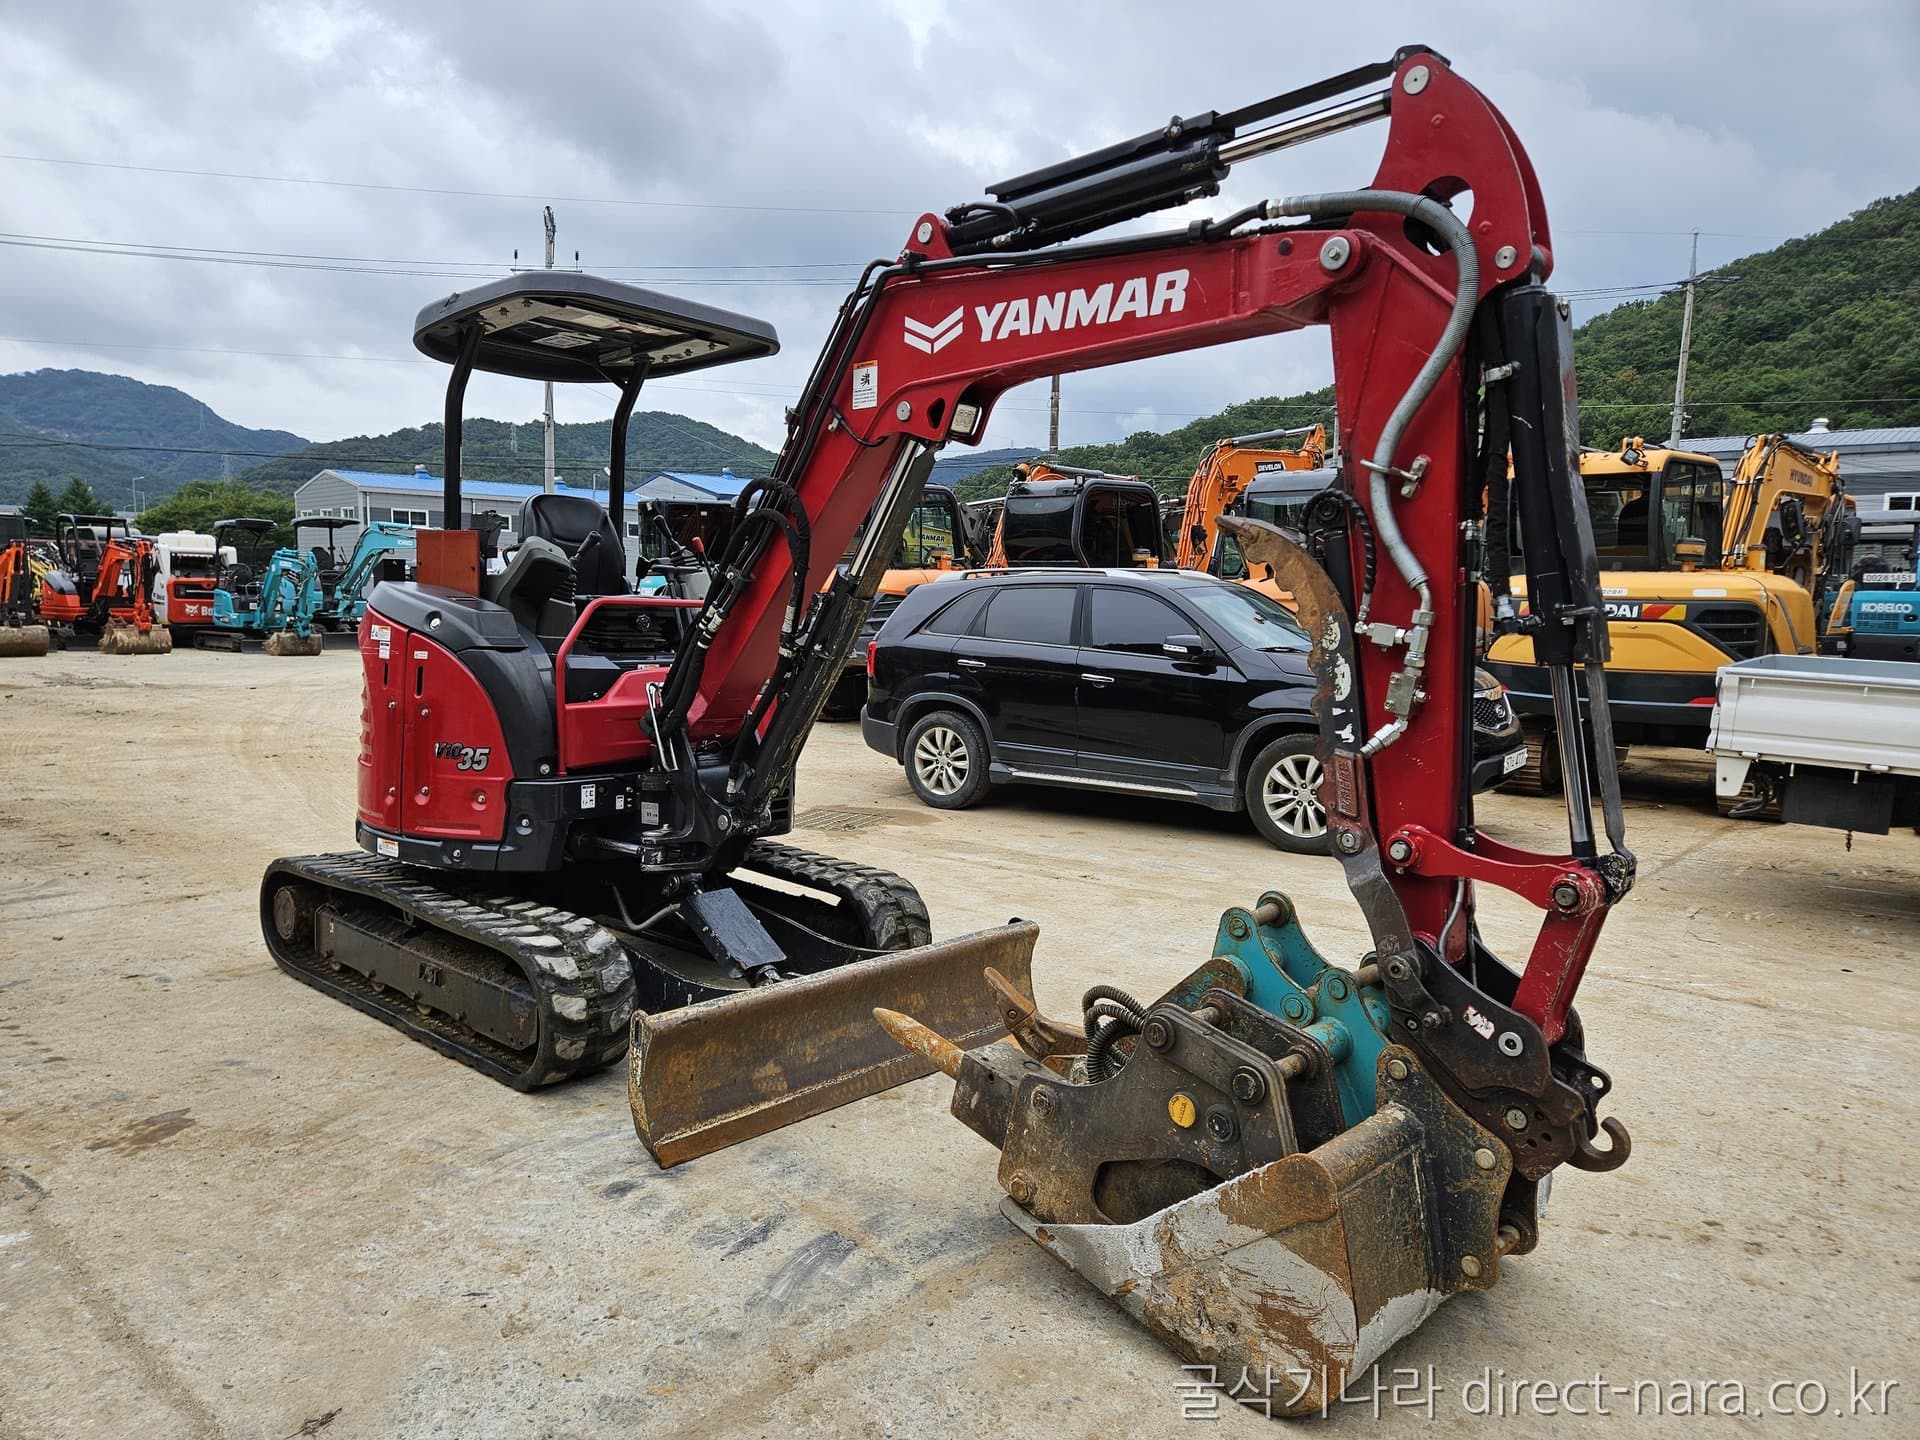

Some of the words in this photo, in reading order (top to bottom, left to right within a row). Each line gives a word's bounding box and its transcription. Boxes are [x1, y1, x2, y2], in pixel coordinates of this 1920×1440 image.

[974, 268, 1190, 343] YANMAR
[1257, 463, 1282, 472] DEVELON
[1789, 468, 1814, 487] HYUNDAI
[919, 534, 945, 543] ANMAR
[1861, 602, 1913, 613] KOBELCO
